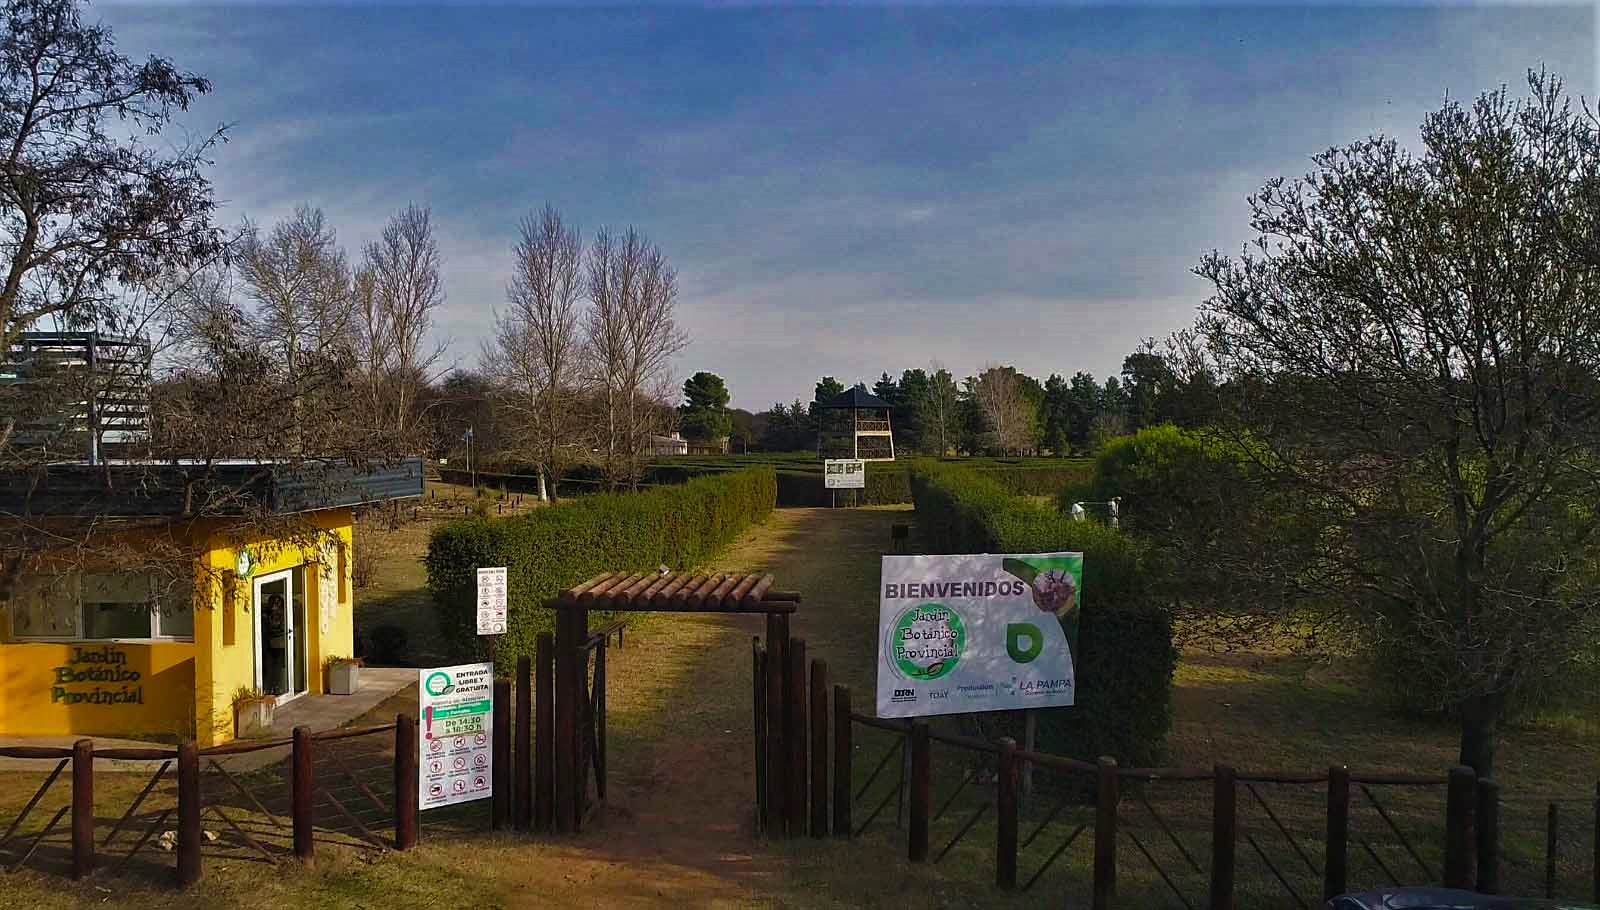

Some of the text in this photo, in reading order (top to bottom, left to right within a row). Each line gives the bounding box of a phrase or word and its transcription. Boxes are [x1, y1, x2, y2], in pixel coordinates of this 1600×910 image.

[885, 581, 1025, 599] BIENVENIDOS
[896, 643, 959, 660] Provincial
[456, 669, 488, 679] ENTRADA
[458, 678, 478, 686] LIBRE
[1020, 680, 1034, 690] LA
[1036, 679, 1072, 689] PAMPA
[455, 684, 489, 694] GRATUITA
[51, 685, 145, 705] Provincial
[445, 716, 481, 728] De 14:30
